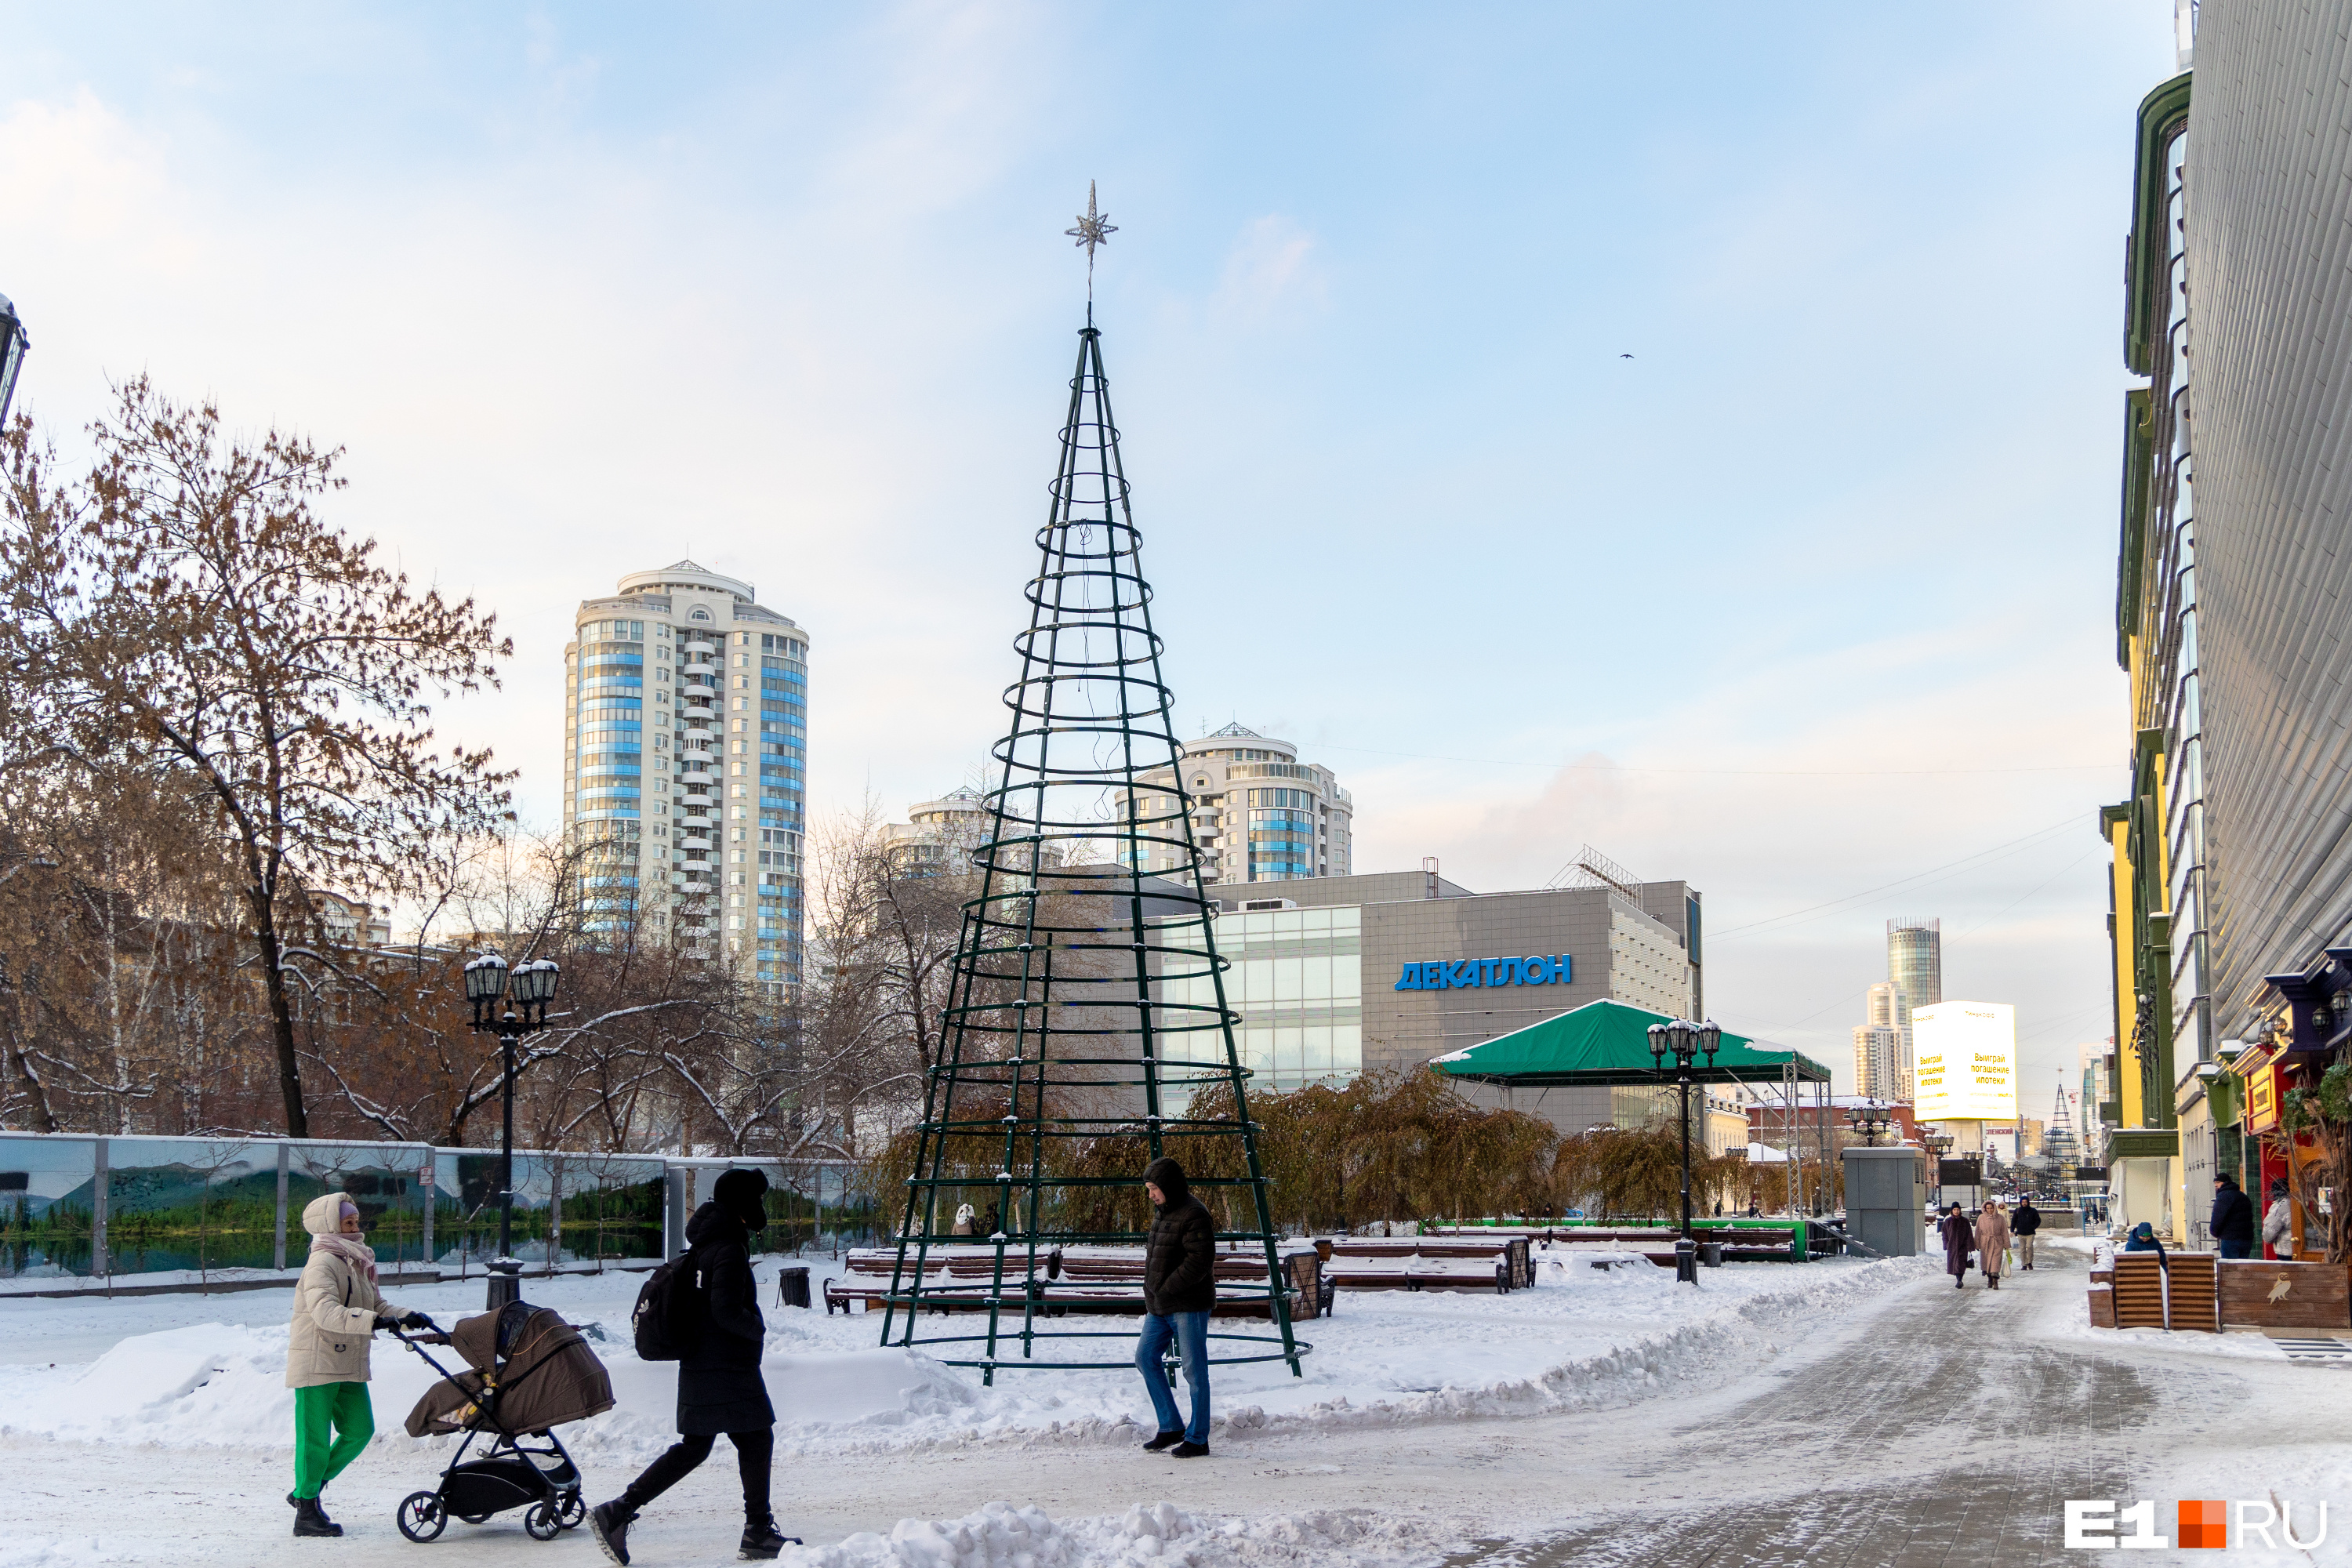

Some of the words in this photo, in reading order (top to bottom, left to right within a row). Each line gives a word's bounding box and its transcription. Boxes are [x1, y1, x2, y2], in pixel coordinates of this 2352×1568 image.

[1394, 953, 1571, 990] ДЕКАТЛОН
[1920, 1053, 1943, 1065] Выиграй
[1975, 1053, 2005, 1065] Выиграй
[1917, 1065, 1946, 1076] погашение
[1970, 1065, 2010, 1074] погашение
[1921, 1076, 1943, 1087] ипотеки
[1976, 1076, 2005, 1085] ипотеки
